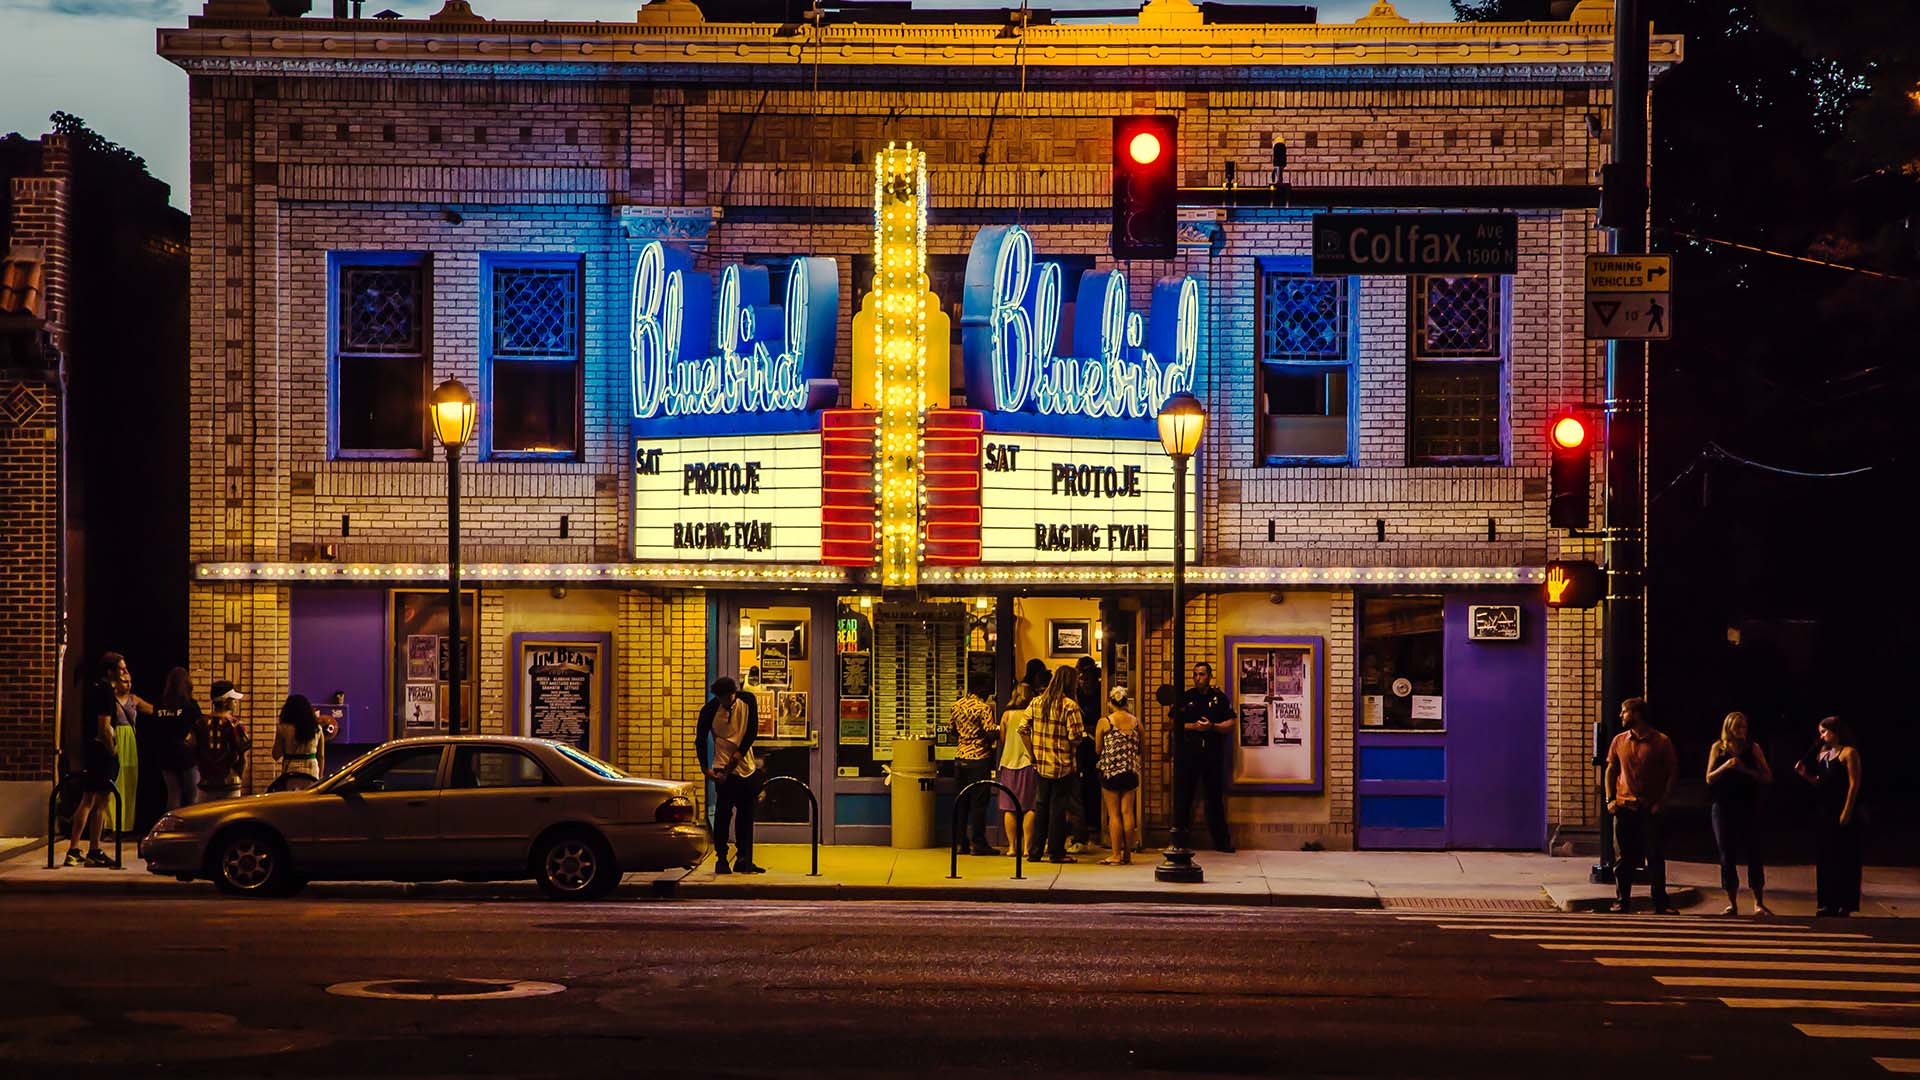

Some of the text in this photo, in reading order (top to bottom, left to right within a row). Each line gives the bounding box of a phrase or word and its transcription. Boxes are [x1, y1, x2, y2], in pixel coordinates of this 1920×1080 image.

[1349, 224, 1463, 265] Colfax
[1476, 223, 1504, 241] Ave
[1466, 247, 1513, 265] 1500 N
[1592, 261, 1642, 272] TURNING
[1591, 276, 1644, 288] VEHICLES
[631, 241, 809, 418] Bluebird
[990, 225, 1199, 418] Bluebird
[636, 448, 663, 475] SAT
[985, 443, 1020, 472] SAT
[684, 461, 761, 496] PROTOJE
[1051, 462, 1142, 499] PROTOJE
[673, 519, 772, 552] RAGING FYAH
[1035, 523, 1149, 551] RAGING FYAH
[533, 648, 595, 667] JIM BEAM
